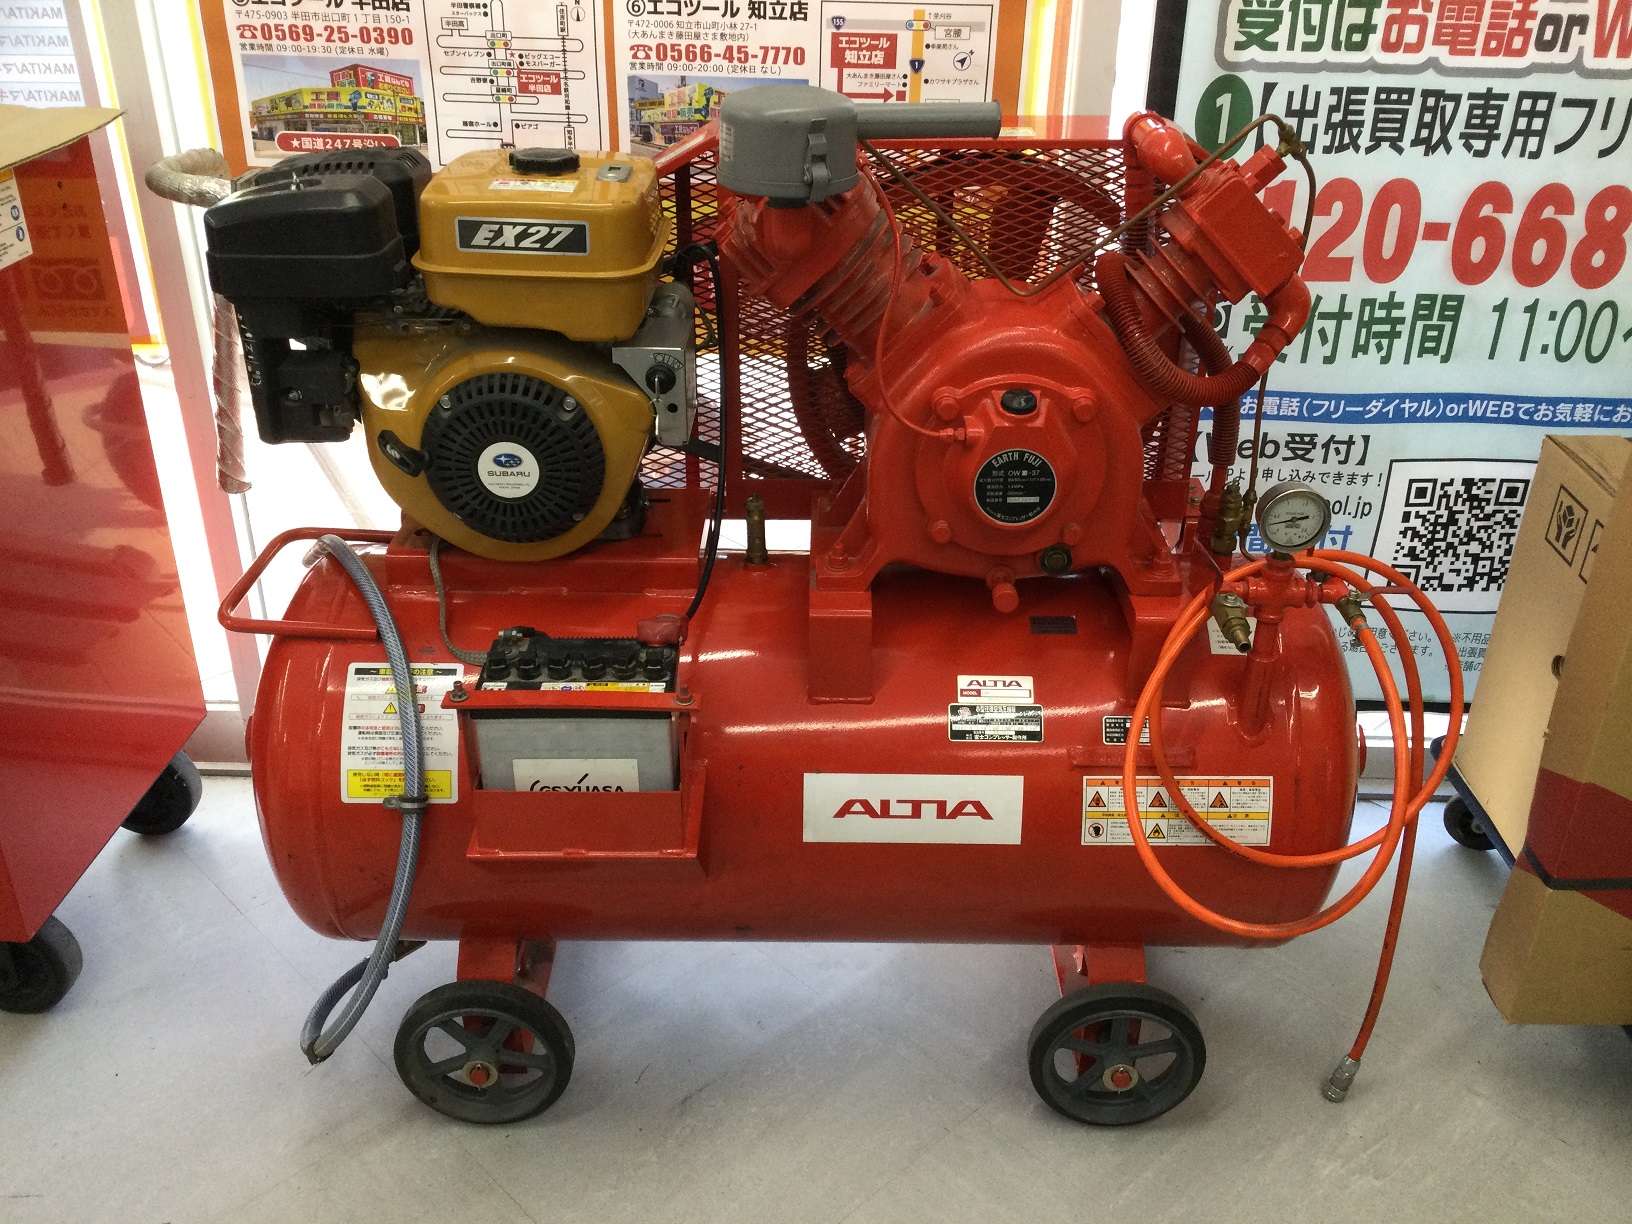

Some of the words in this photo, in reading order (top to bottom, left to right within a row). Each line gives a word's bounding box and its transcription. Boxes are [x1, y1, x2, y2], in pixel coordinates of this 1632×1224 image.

[748, 0, 809, 21] 知立店
[291, 11, 350, 23] 半田市出口町
[385, 14, 410, 24] 150-1
[676, 20, 738, 30] 知立市山町小林
[739, 22, 757, 31] 27-1
[261, 23, 414, 45] 0569-25-0390
[239, 43, 274, 53] 営業時間
[276, 44, 332, 54] 09:00-19:30
[838, 36, 891, 49] エコツール
[655, 42, 806, 66] 0566-45-7770
[844, 51, 885, 65] 知立店
[629, 62, 664, 72] 営業時間
[667, 63, 724, 73] 09:00-20:00
[520, 73, 559, 83] エコツール
[528, 84, 552, 93] 半田店
[1216, 92, 1233, 145] 1
[471, 223, 575, 249] EX27
[992, 452, 1019, 468] EARTH
[1023, 453, 1042, 468] FUJI
[487, 470, 531, 478] SUBARU
[967, 680, 1022, 688] ALTIA
[832, 798, 994, 821] ALTIA
